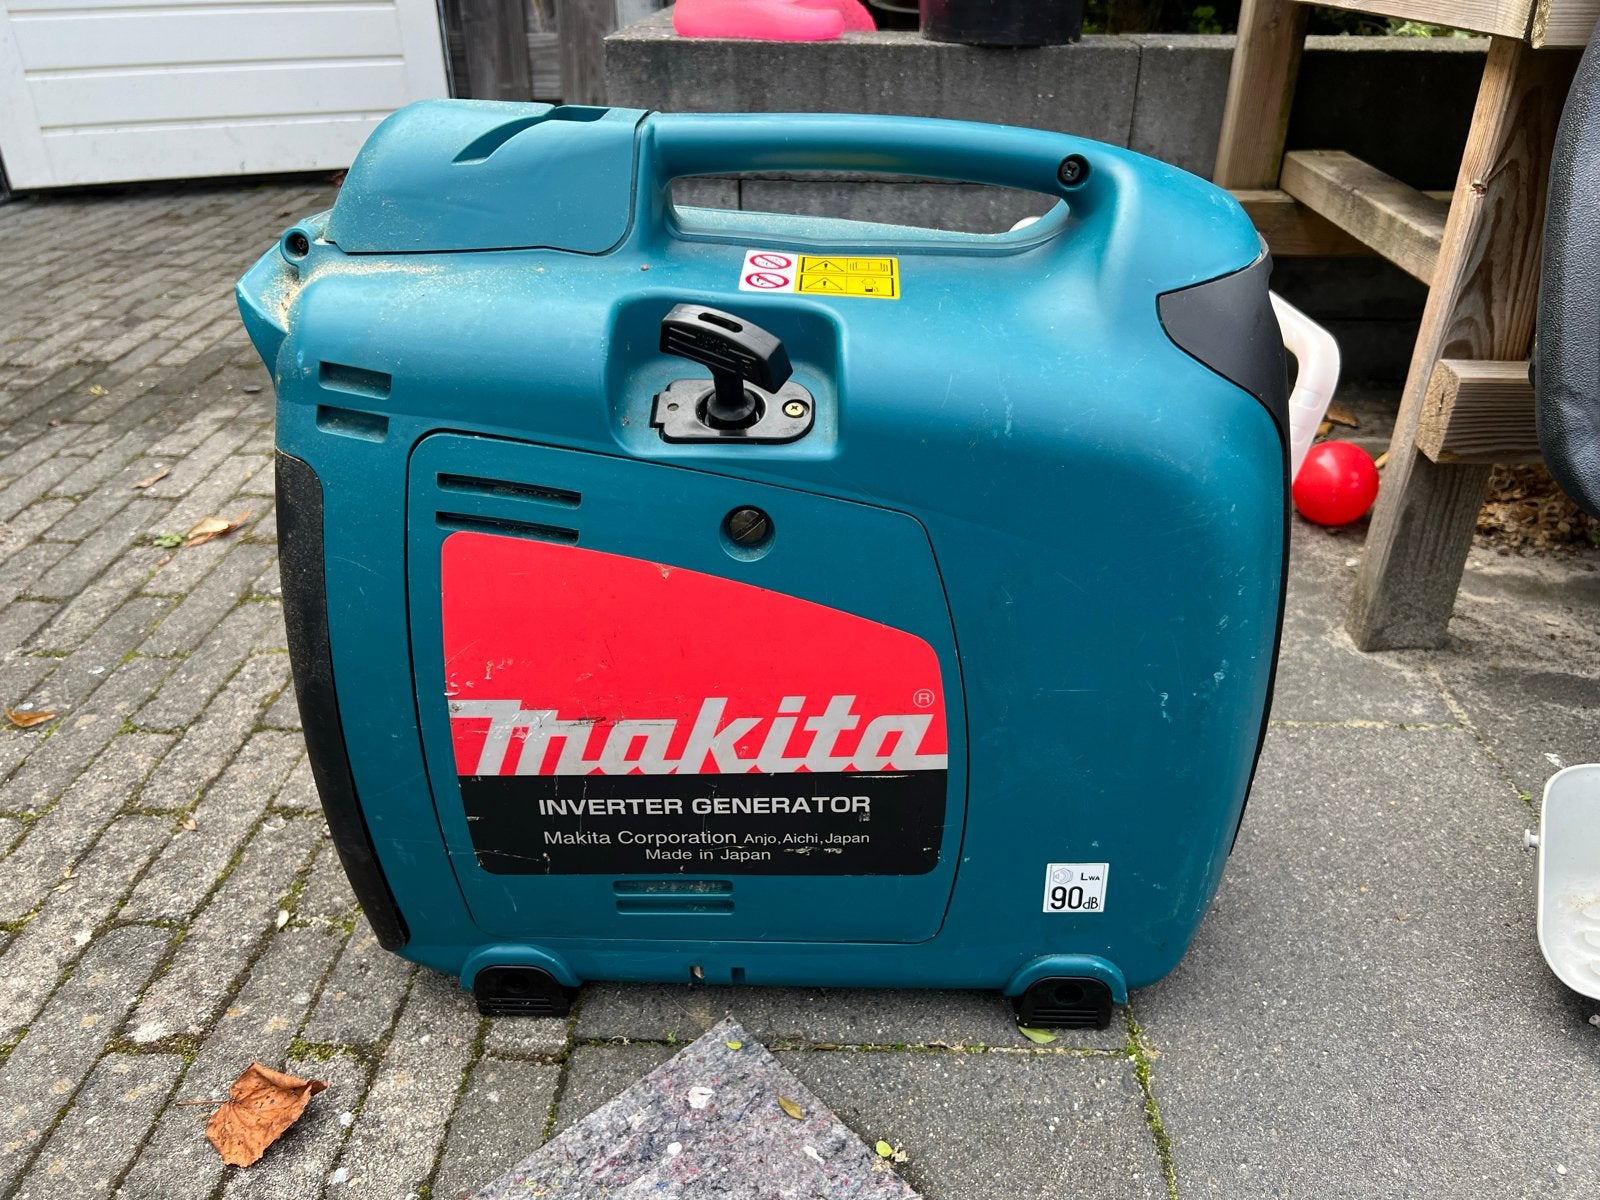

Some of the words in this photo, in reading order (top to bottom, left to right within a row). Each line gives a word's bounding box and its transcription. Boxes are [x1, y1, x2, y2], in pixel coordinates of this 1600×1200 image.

[538, 798, 684, 816] INVERTER
[691, 796, 871, 815] GENERATOR
[543, 830, 612, 845] Makita
[617, 829, 737, 847] Corporation
[645, 848, 693, 861] Made
[699, 848, 714, 861] in
[720, 848, 771, 863] Japan
